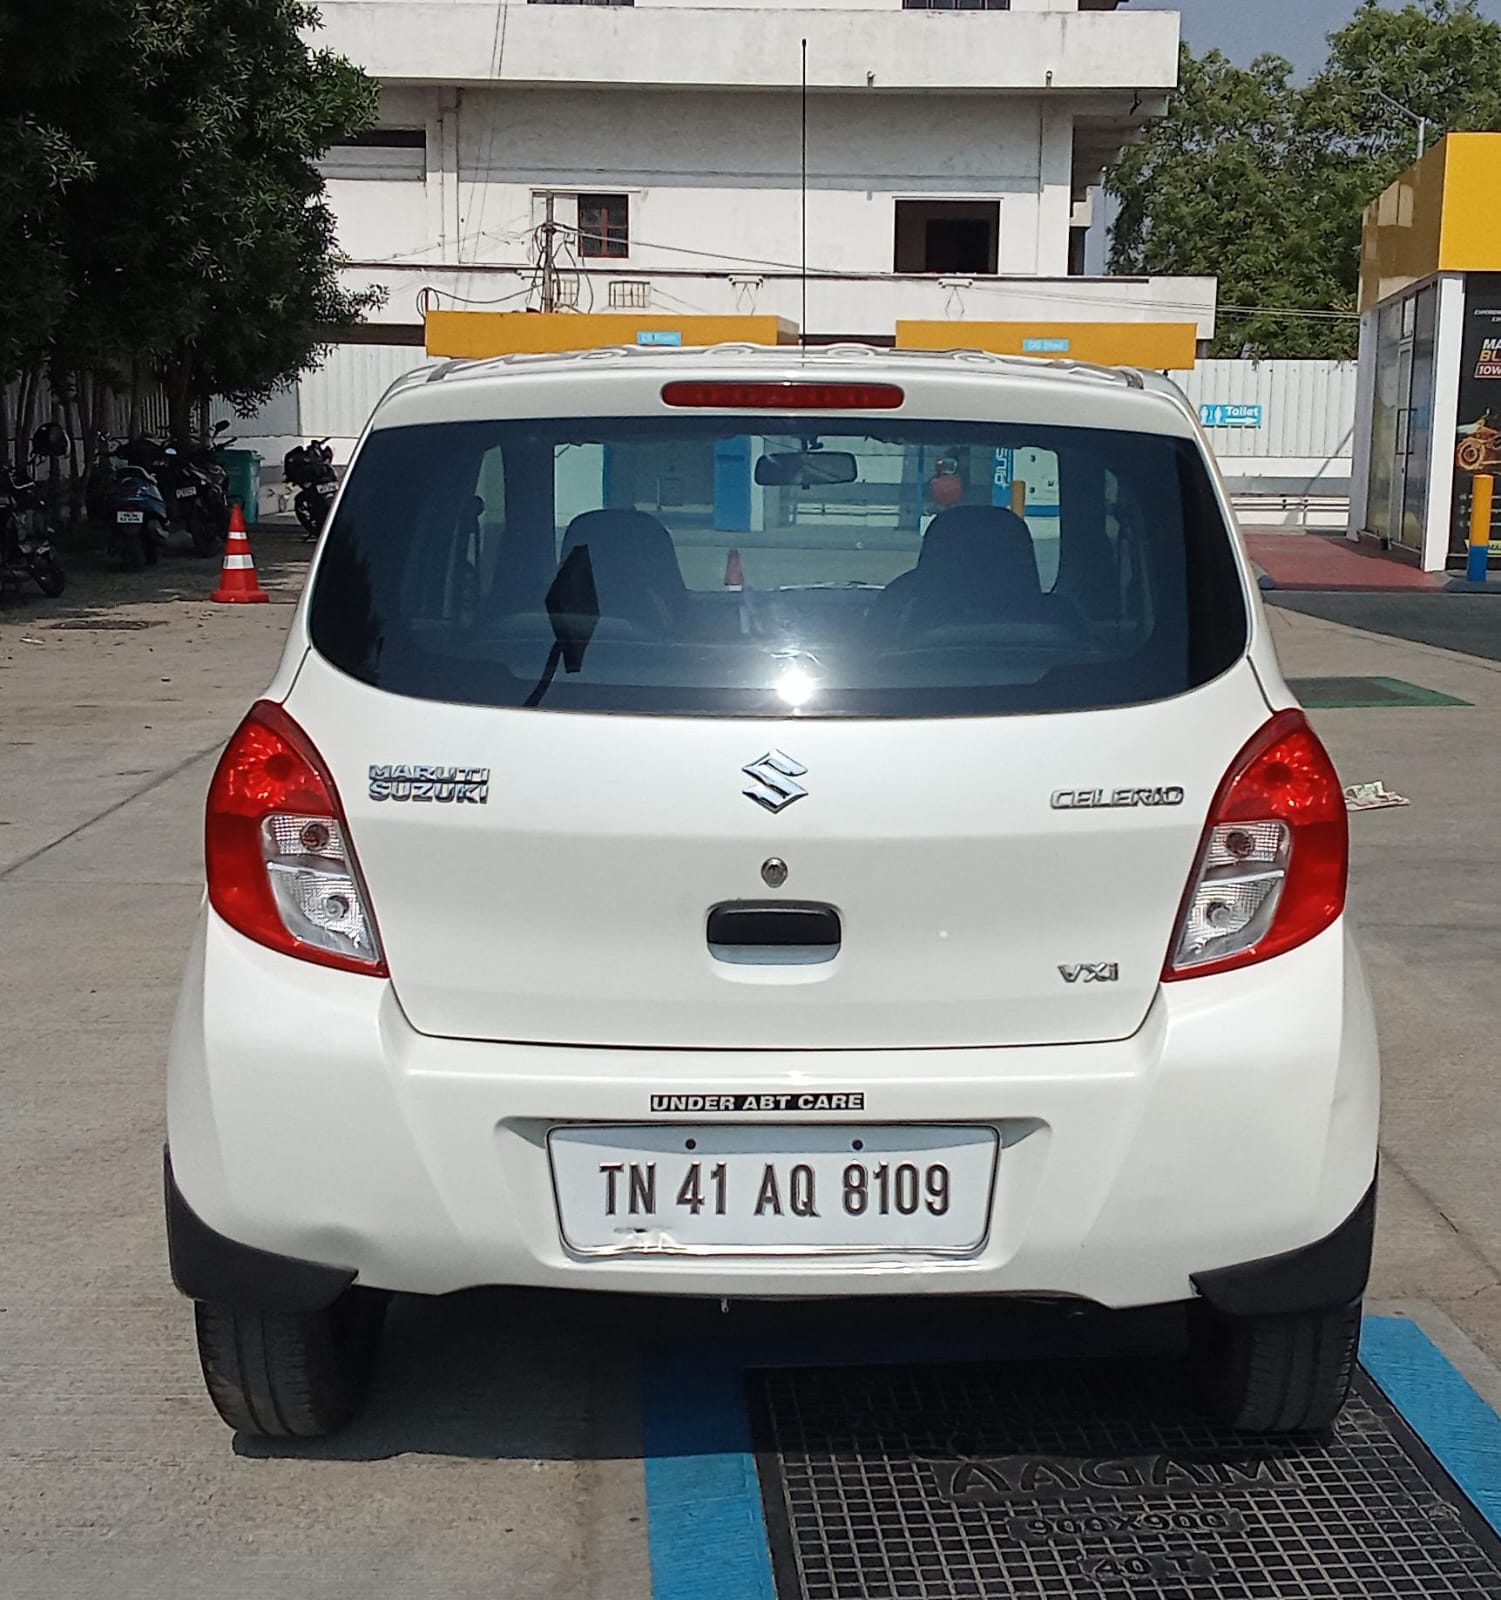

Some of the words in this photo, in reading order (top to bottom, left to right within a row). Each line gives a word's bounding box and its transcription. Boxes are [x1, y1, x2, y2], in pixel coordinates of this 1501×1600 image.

[1226, 406, 1258, 416] Toilet
[368, 765, 490, 783] MARUTI
[368, 781, 489, 804] SUZUKI
[1051, 787, 1184, 809] CELERIO
[652, 1096, 735, 1111] UNDER
[742, 1095, 791, 1110] ABT
[797, 1094, 863, 1109] CARE
[600, 1161, 657, 1216] TN
[676, 1161, 728, 1216] 41
[754, 1161, 821, 1217] AQ
[842, 1161, 951, 1216] 8109
[951, 1456, 1289, 1495] AAGAM
[1096, 1555, 1153, 1576] 40
[1164, 1555, 1194, 1575] T
